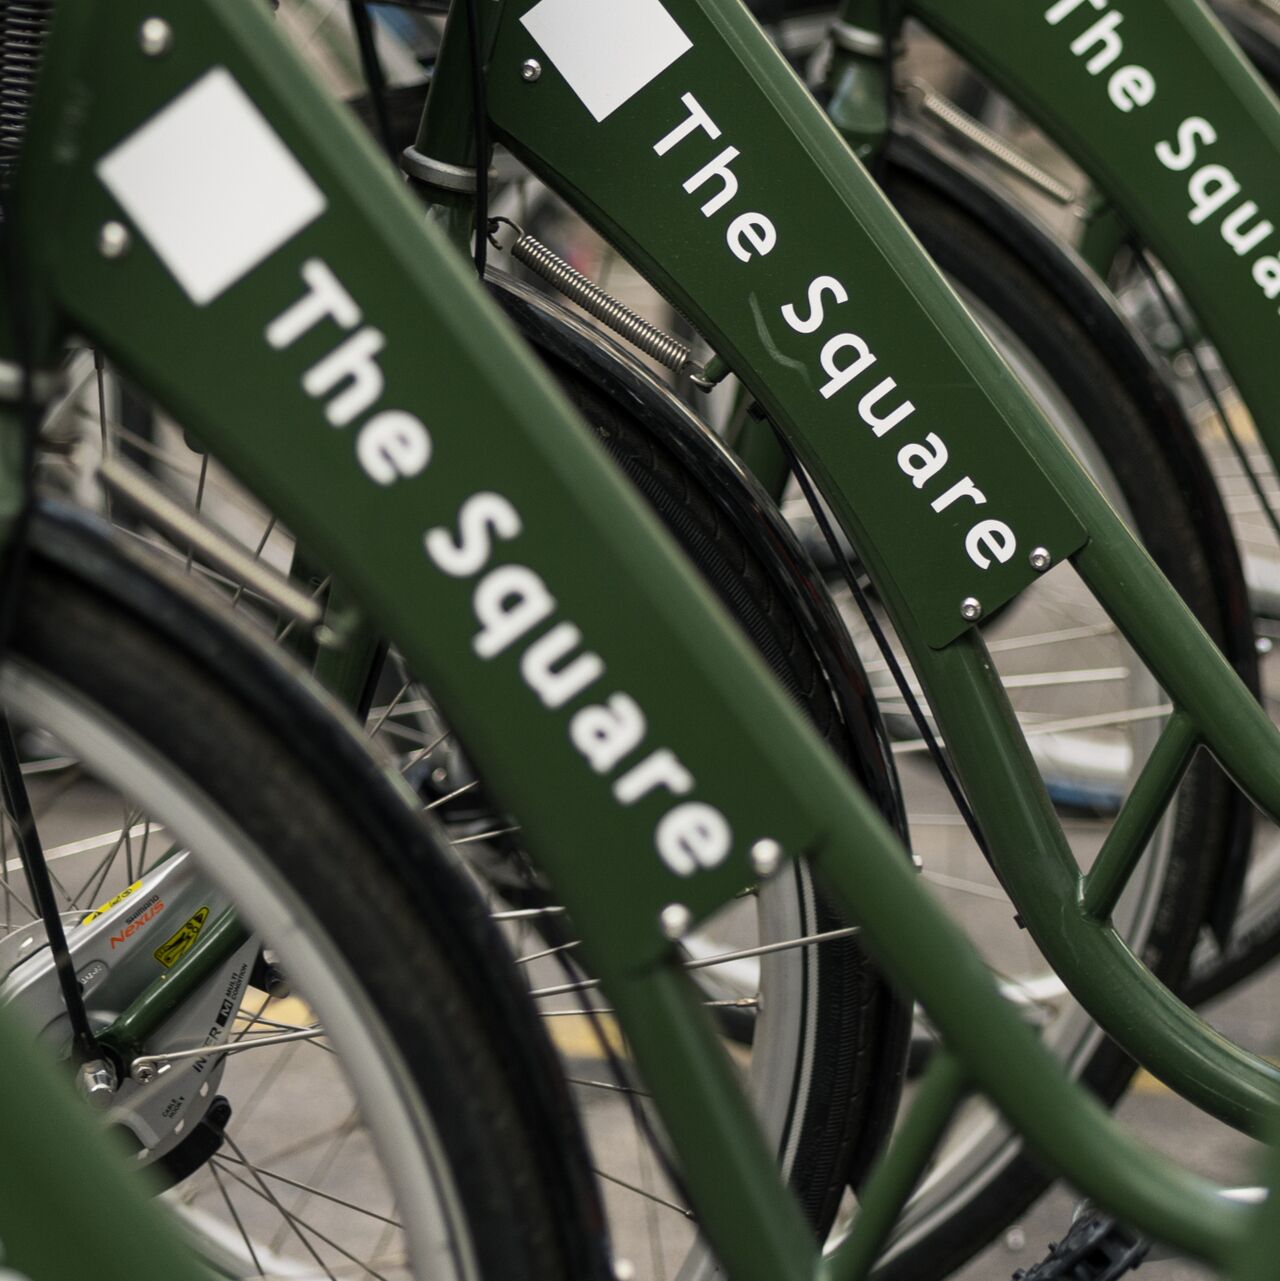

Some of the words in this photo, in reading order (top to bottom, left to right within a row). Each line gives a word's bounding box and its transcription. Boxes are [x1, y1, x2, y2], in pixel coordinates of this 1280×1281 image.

[264, 257, 434, 487] The
[423, 490, 733, 877] Square
[652, 91, 778, 263] The
[780, 275, 1018, 571] Square
[125, 894, 160, 925] SHIMANO
